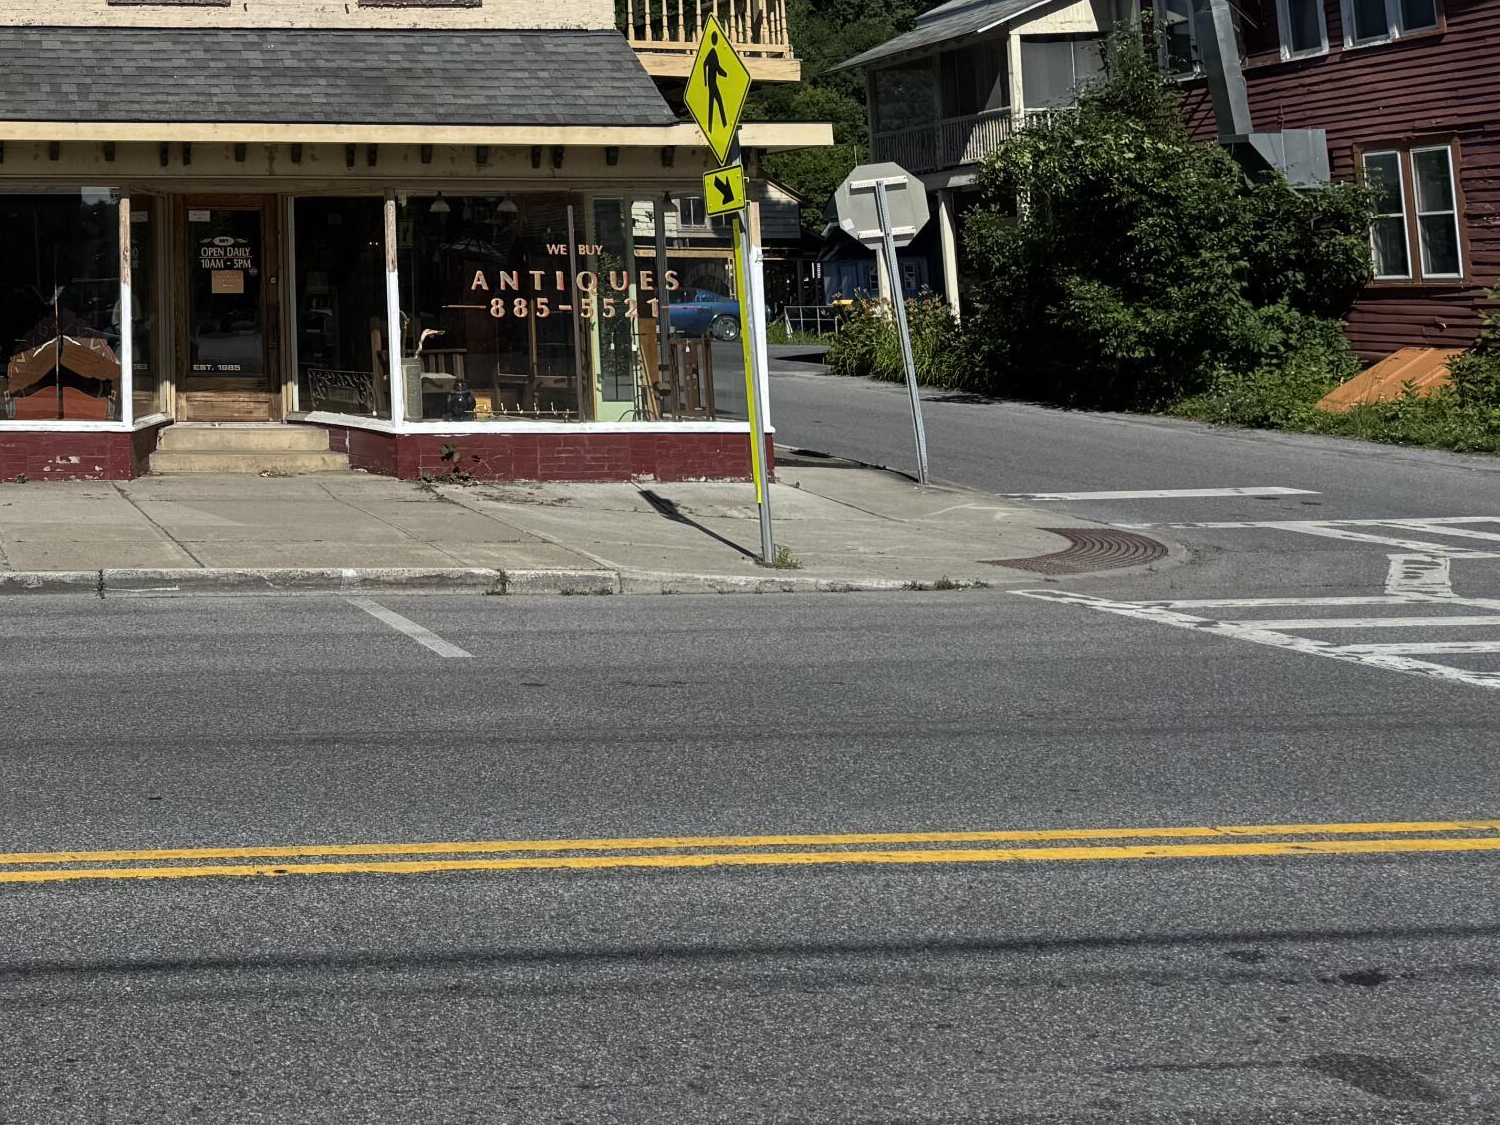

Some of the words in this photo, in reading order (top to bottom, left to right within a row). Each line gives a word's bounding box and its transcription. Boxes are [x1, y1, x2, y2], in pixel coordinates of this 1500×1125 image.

[200, 246, 224, 257] OPEN
[226, 246, 251, 257] DAILY
[546, 243, 568, 256] WE
[577, 243, 603, 256] BUY
[200, 258, 224, 269] 10AM
[233, 258, 252, 269] 5PM
[471, 270, 680, 295] ANTIQUES
[490, 297, 660, 318] 885-5521
